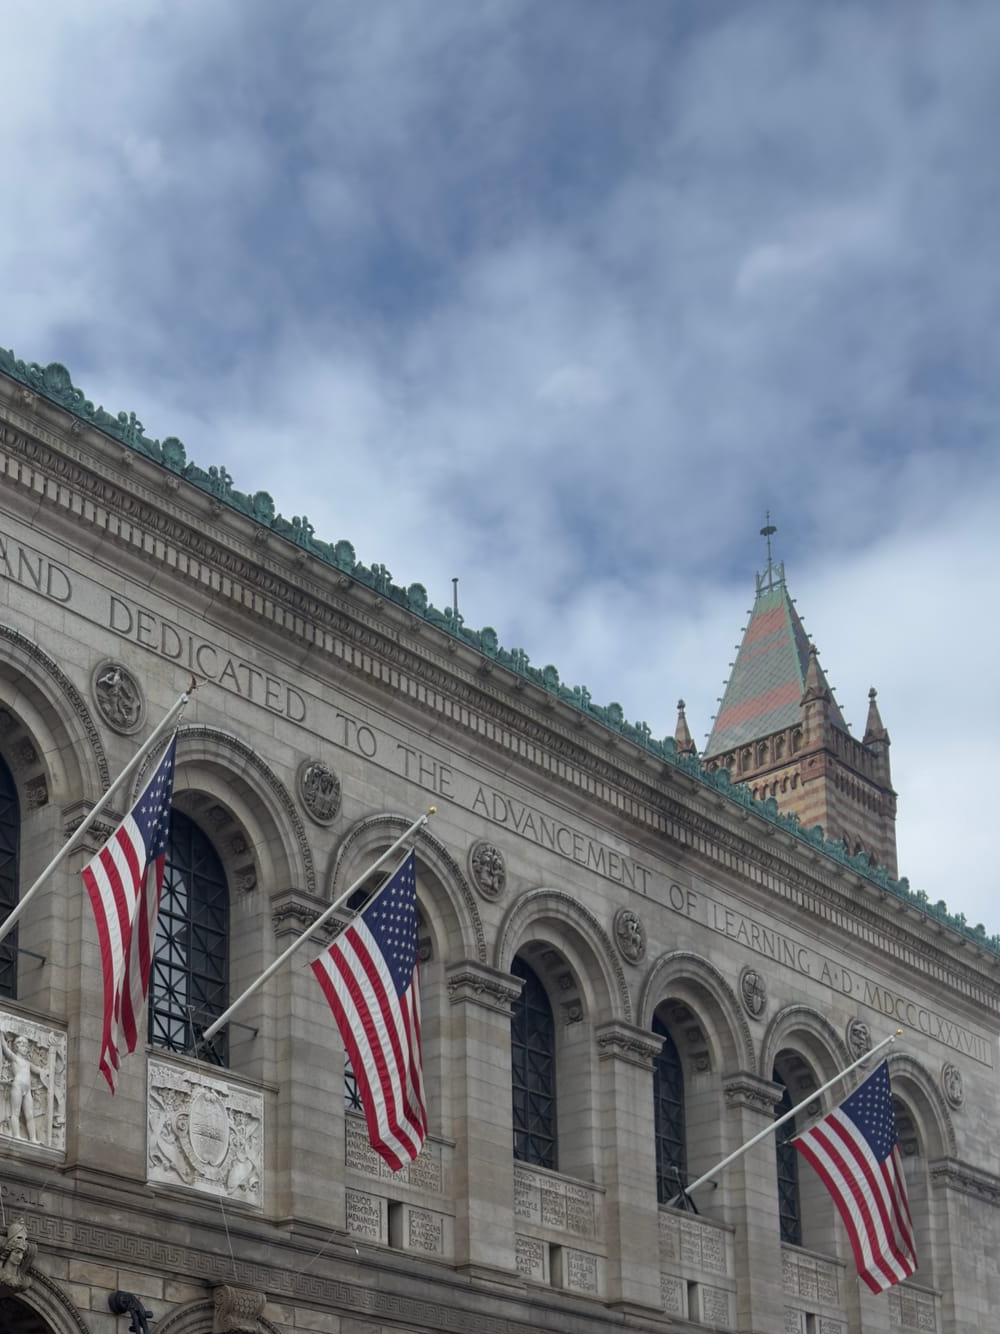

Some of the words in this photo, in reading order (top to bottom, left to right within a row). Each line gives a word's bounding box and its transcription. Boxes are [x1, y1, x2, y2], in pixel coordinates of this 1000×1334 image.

[109, 595, 306, 722] DEDICATED
[336, 713, 377, 757] TO
[397, 744, 455, 799] THE
[472, 787, 652, 895] ADVANCEMENT
[669, 884, 698, 916] OF
[713, 904, 811, 975] LEARNING
